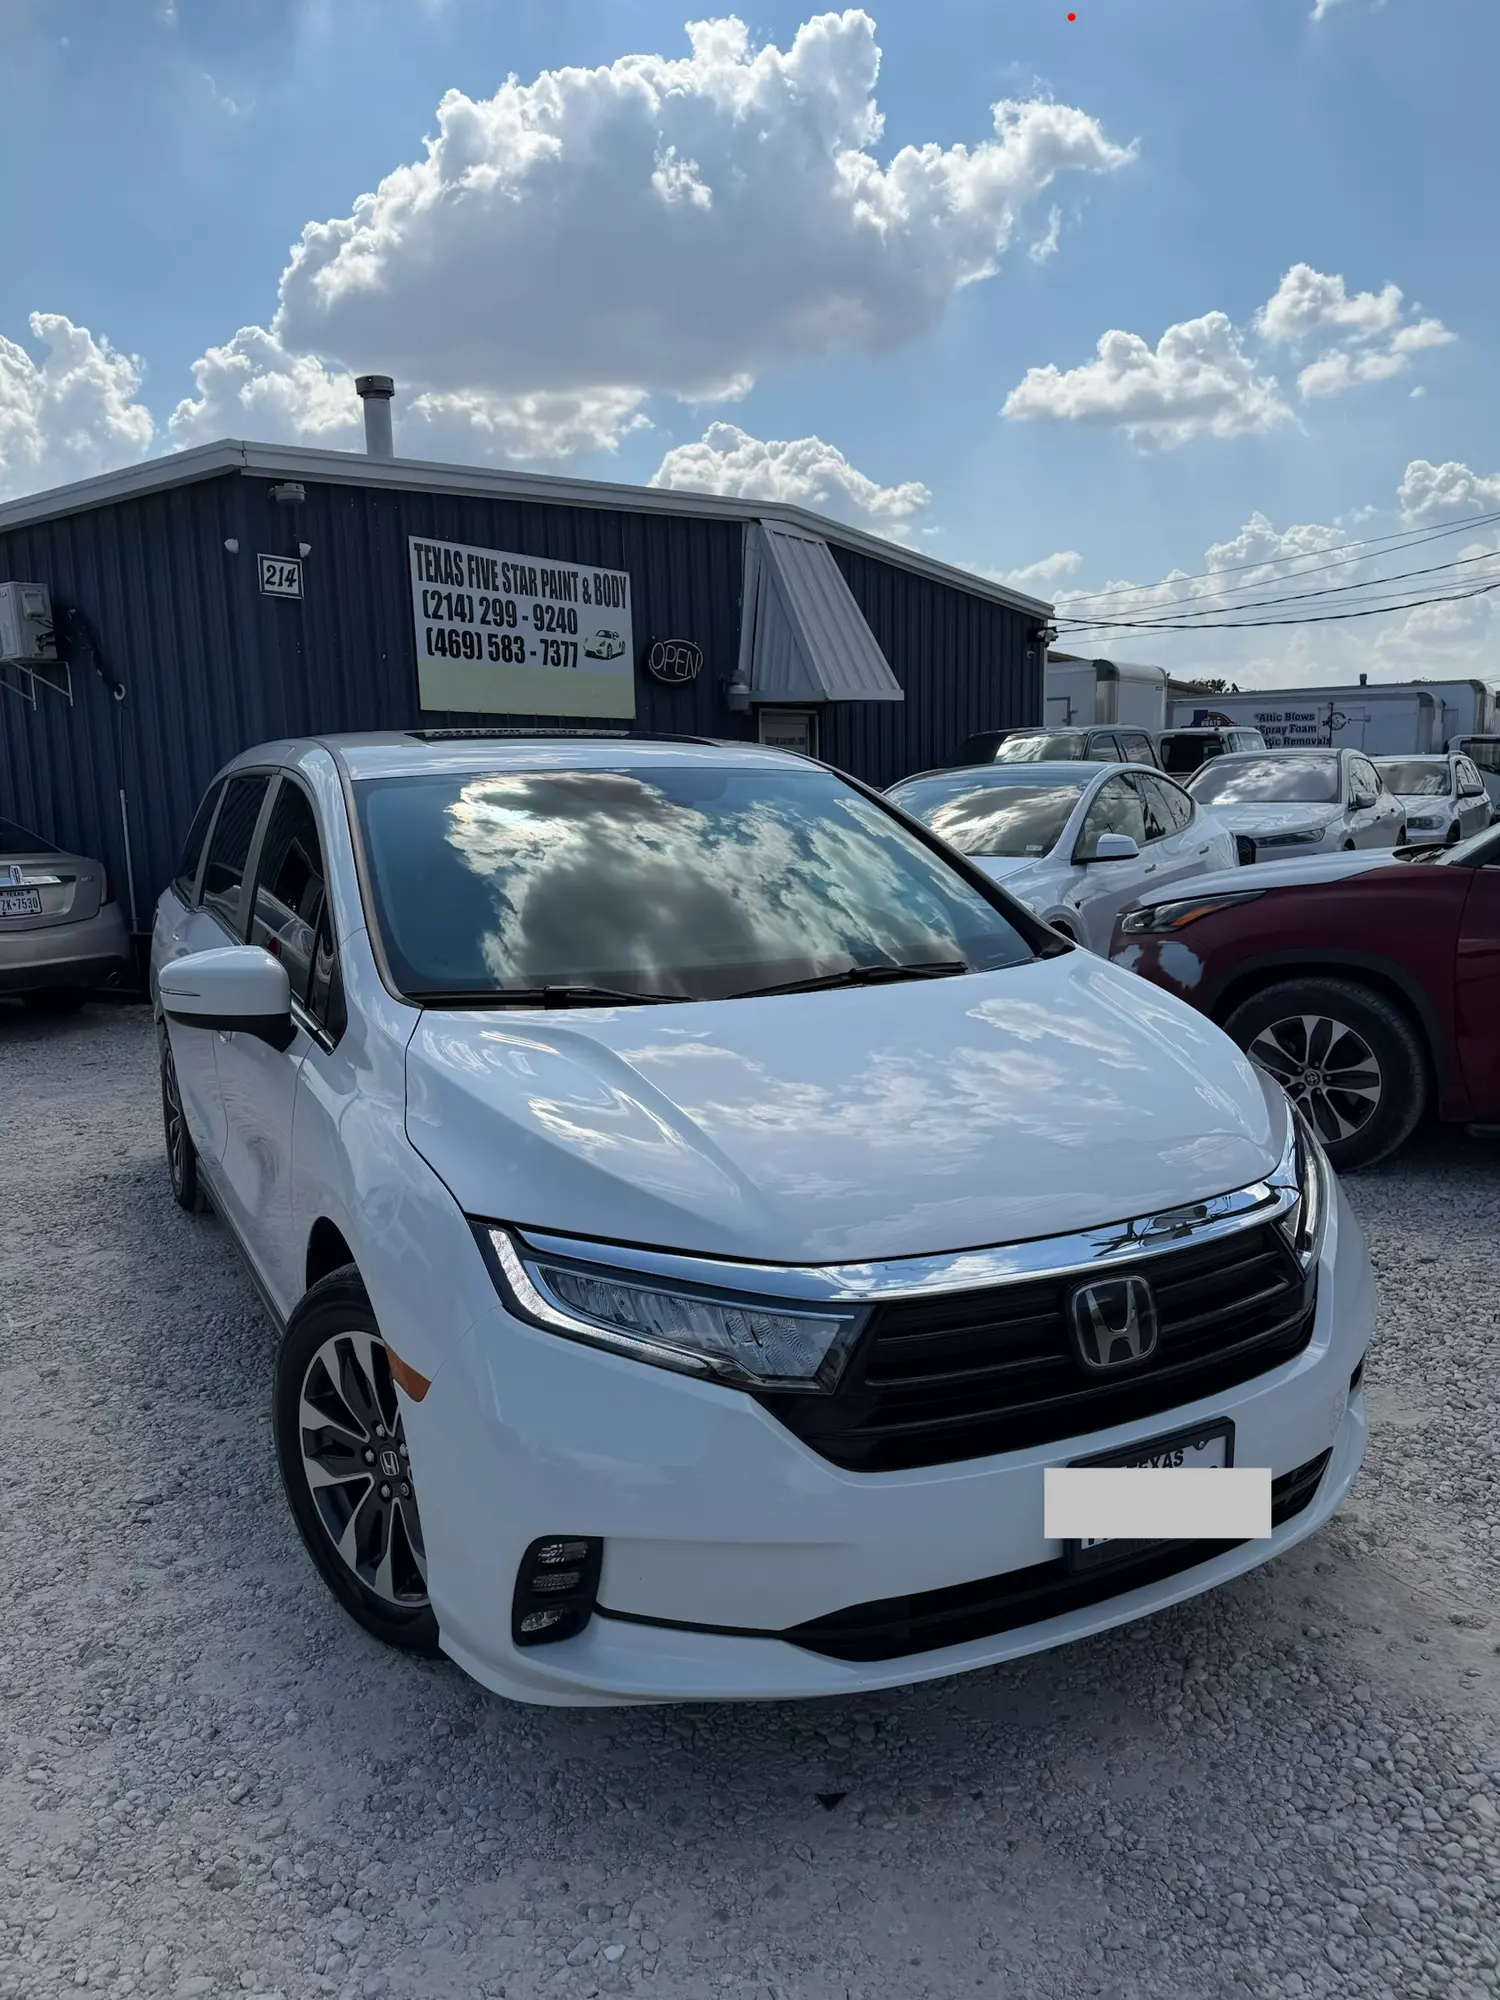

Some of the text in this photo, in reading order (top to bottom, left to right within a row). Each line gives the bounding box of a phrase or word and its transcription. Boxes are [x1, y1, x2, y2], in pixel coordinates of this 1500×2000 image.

[265, 564, 297, 588] 214
[413, 542, 627, 609] TEXAS FIVE STAR PAINT & BODY
[422, 589, 475, 624] (214)
[478, 596, 518, 629] 299
[532, 603, 578, 635] 9240
[426, 627, 483, 661] (469)
[487, 633, 526, 664] 583
[540, 638, 578, 669] 7377
[650, 641, 700, 679] OPEN
[1284, 712, 1316, 721] Blows
[1289, 724, 1317, 733] Foam
